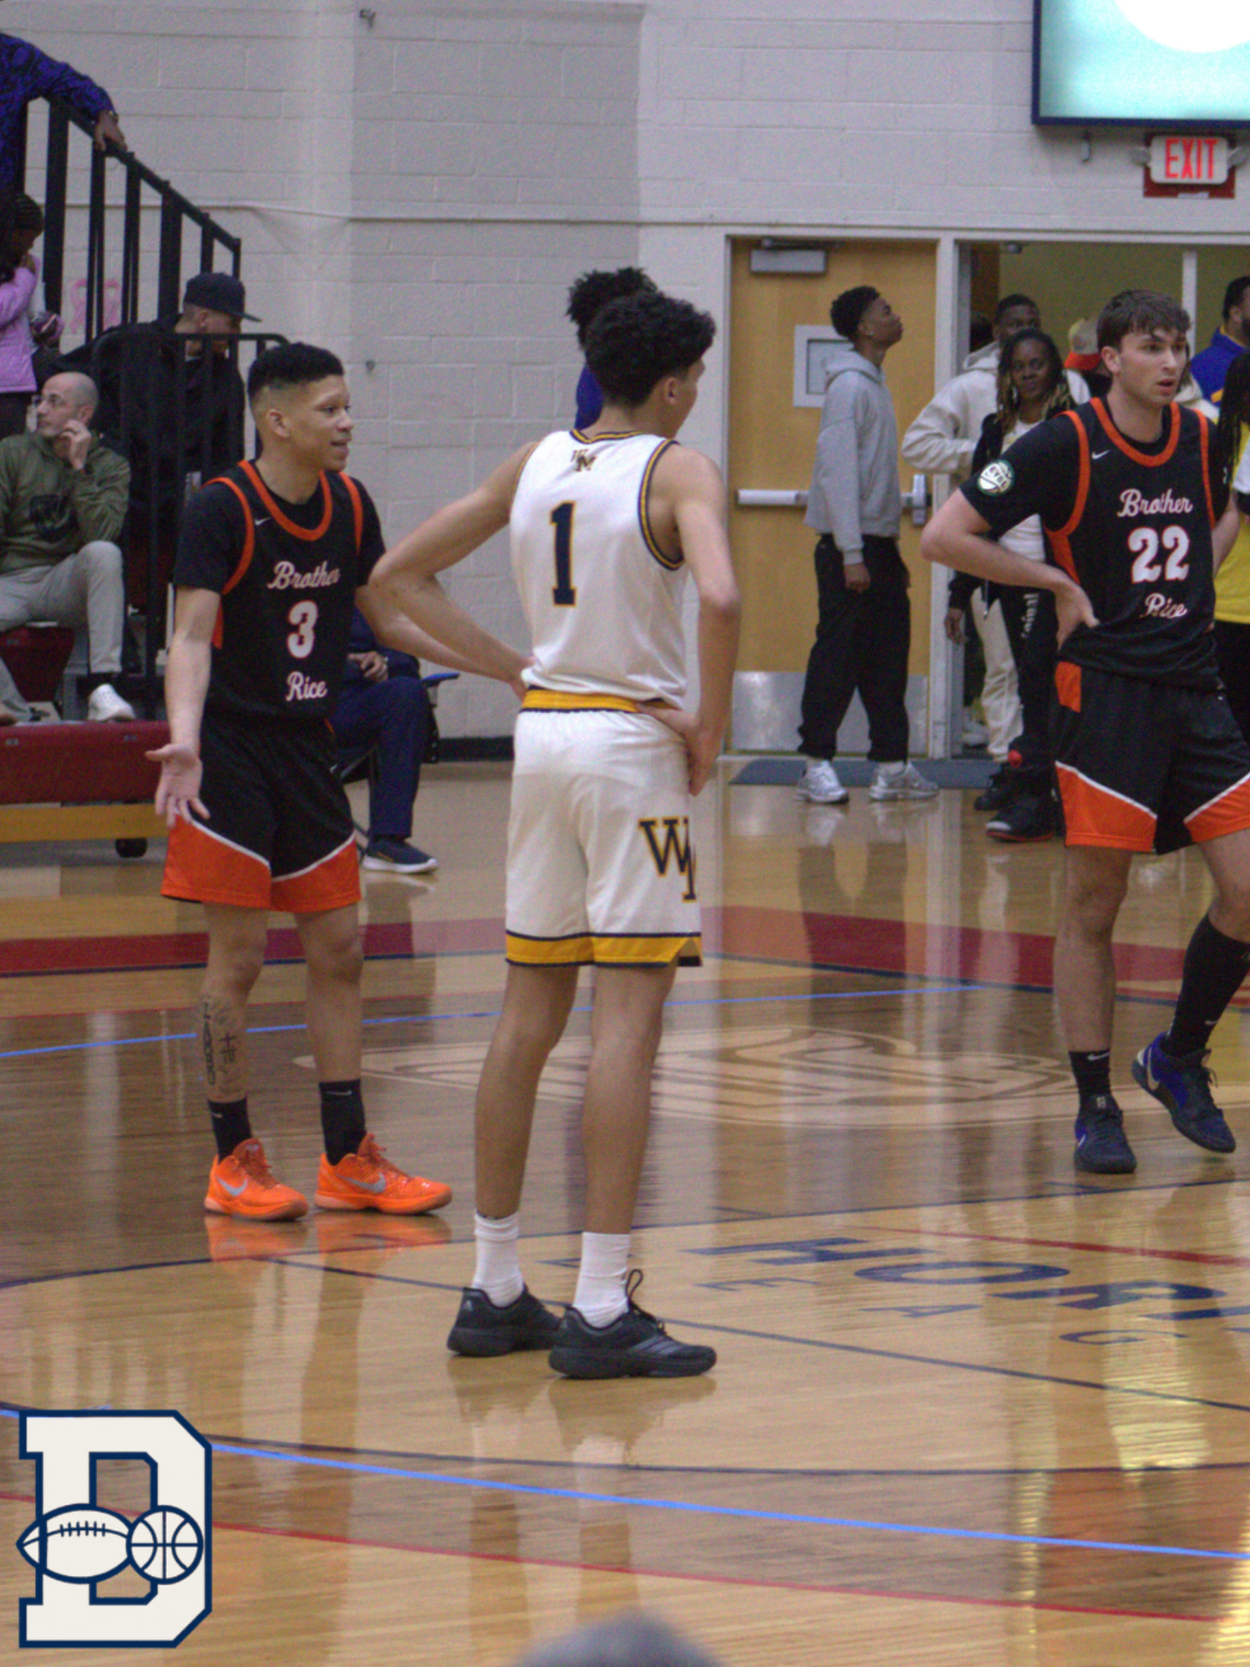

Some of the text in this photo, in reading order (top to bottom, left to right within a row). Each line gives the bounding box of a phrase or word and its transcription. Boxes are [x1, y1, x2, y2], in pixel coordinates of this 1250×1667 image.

[1165, 138, 1219, 179] EXIT
[1116, 487, 1194, 517] Brother
[549, 500, 577, 608] 1
[1127, 524, 1191, 584] 22
[1139, 591, 1189, 619] Rice
[286, 599, 319, 659] 3
[284, 670, 328, 702] Rice
